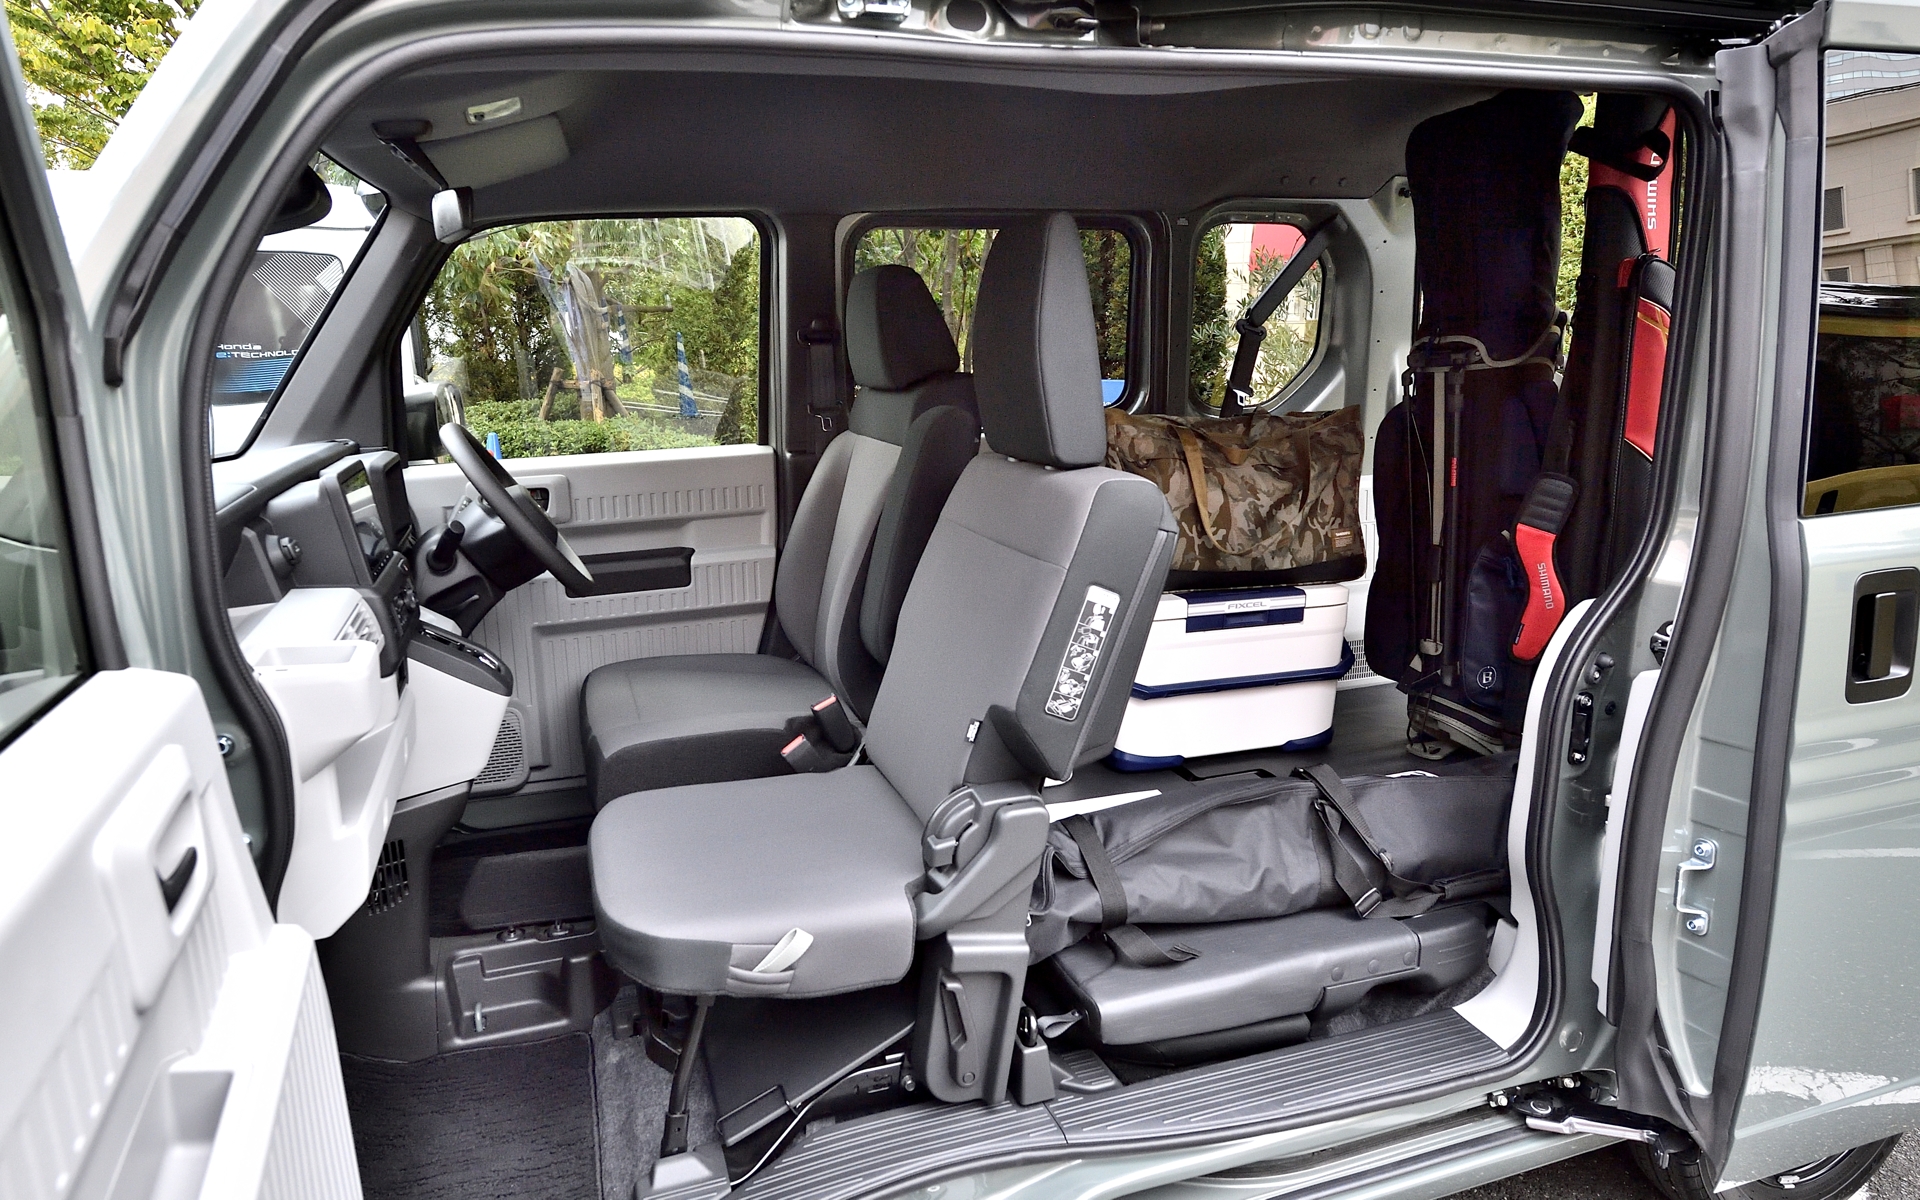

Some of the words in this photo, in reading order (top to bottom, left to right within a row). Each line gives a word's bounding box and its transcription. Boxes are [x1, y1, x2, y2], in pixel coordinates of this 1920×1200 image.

[1647, 152, 1661, 230] SHIMN
[1227, 601, 1267, 610] FIXCEL
[1537, 562, 1554, 610] SHIMANO
